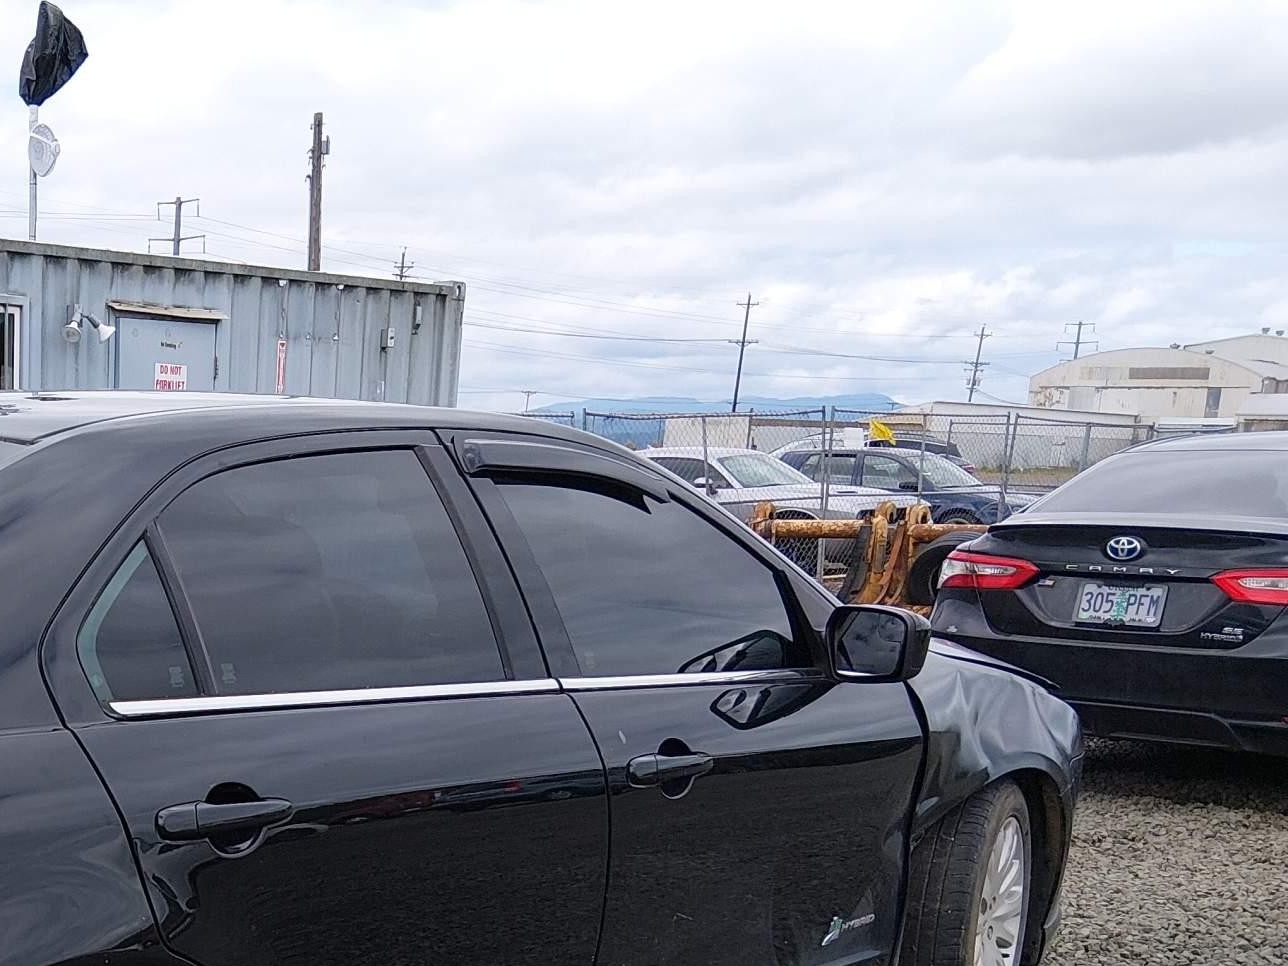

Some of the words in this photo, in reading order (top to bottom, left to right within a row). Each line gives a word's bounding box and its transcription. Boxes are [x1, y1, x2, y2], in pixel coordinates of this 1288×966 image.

[159, 364, 169, 375] DO
[170, 365, 183, 376] NOT
[155, 378, 185, 390] FORKLIFT
[1065, 564, 1181, 575] CAMRY
[1081, 591, 1116, 614] 305
[1125, 593, 1161, 617] PFM
